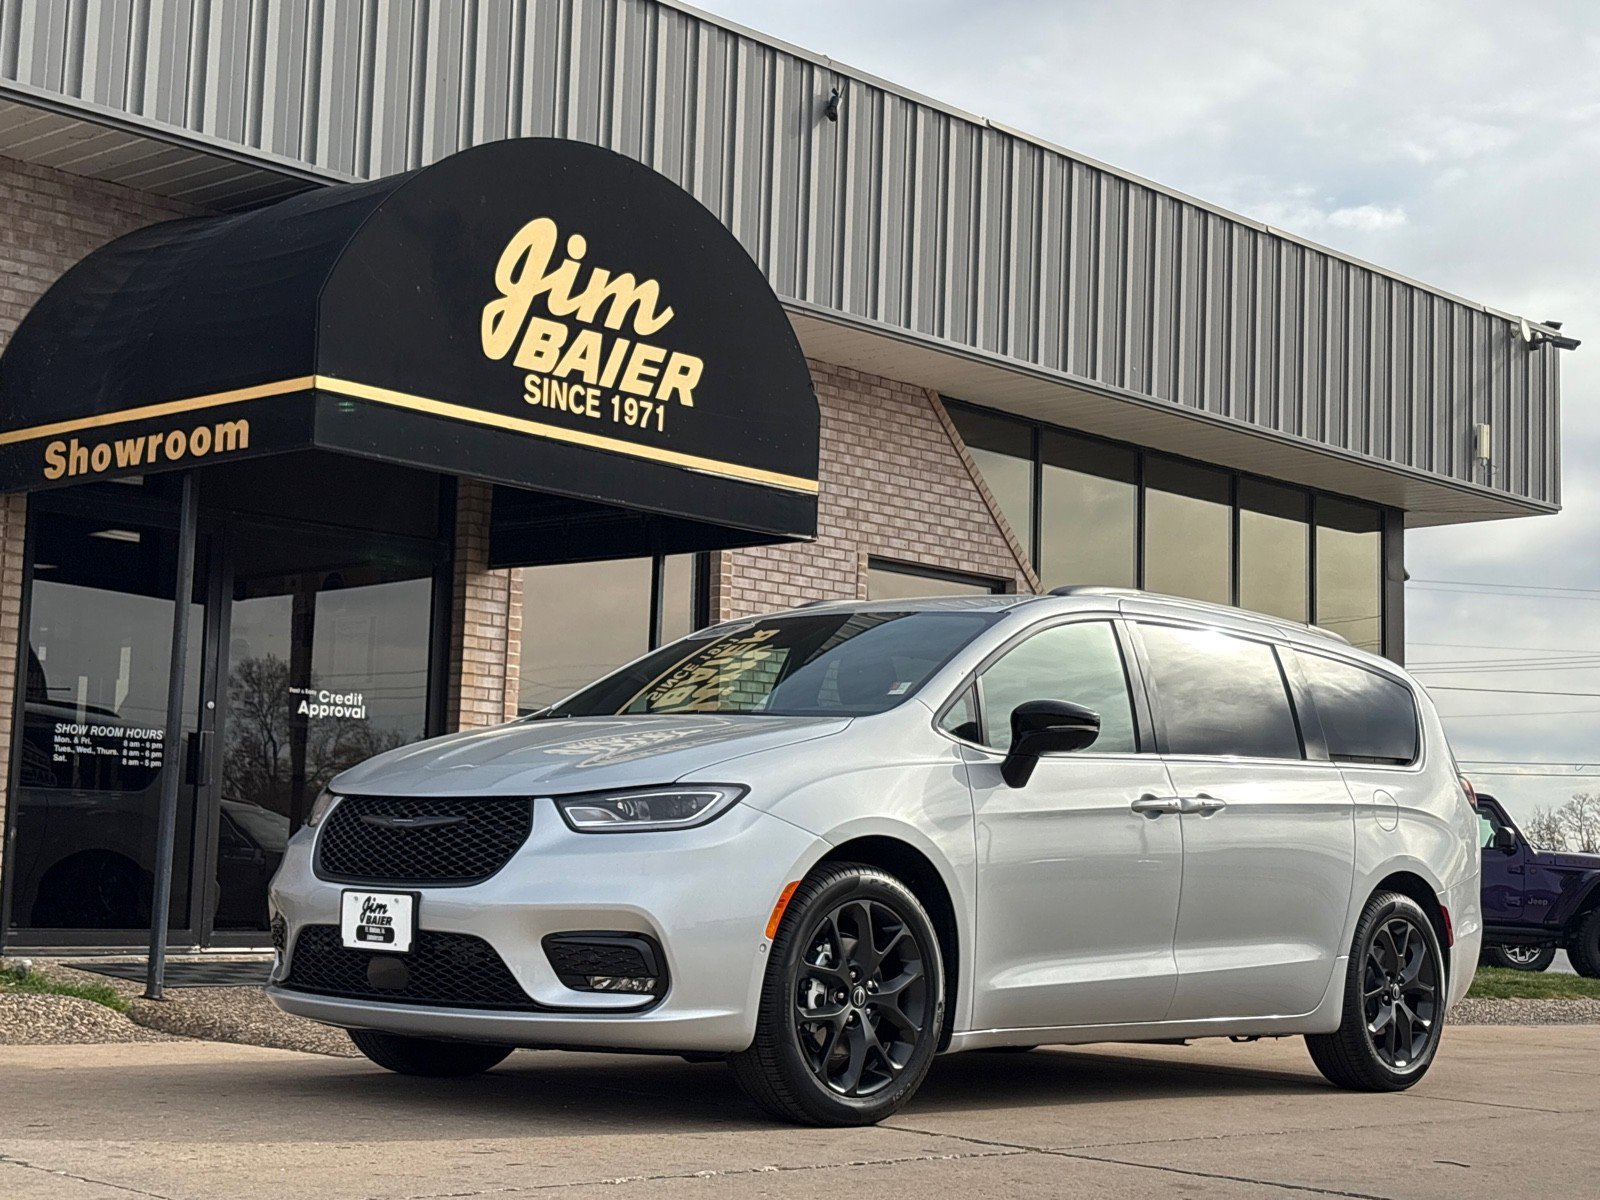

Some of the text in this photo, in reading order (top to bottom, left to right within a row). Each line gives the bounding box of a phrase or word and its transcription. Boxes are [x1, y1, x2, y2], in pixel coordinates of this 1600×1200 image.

[481, 217, 675, 360] Jim
[513, 316, 704, 407] BAIER
[523, 374, 665, 432] SINCE 1971
[43, 419, 250, 480] Showroom
[319, 690, 363, 705] Credit
[297, 700, 366, 719] Approval
[54, 735, 71, 743] Mon.
[55, 723, 163, 740] SHOW ROOM HOURS
[53, 754, 67, 762] Sat.
[97, 747, 119, 755] Thurs.
[360, 896, 388, 923] Jim
[366, 915, 393, 926] BAIER
